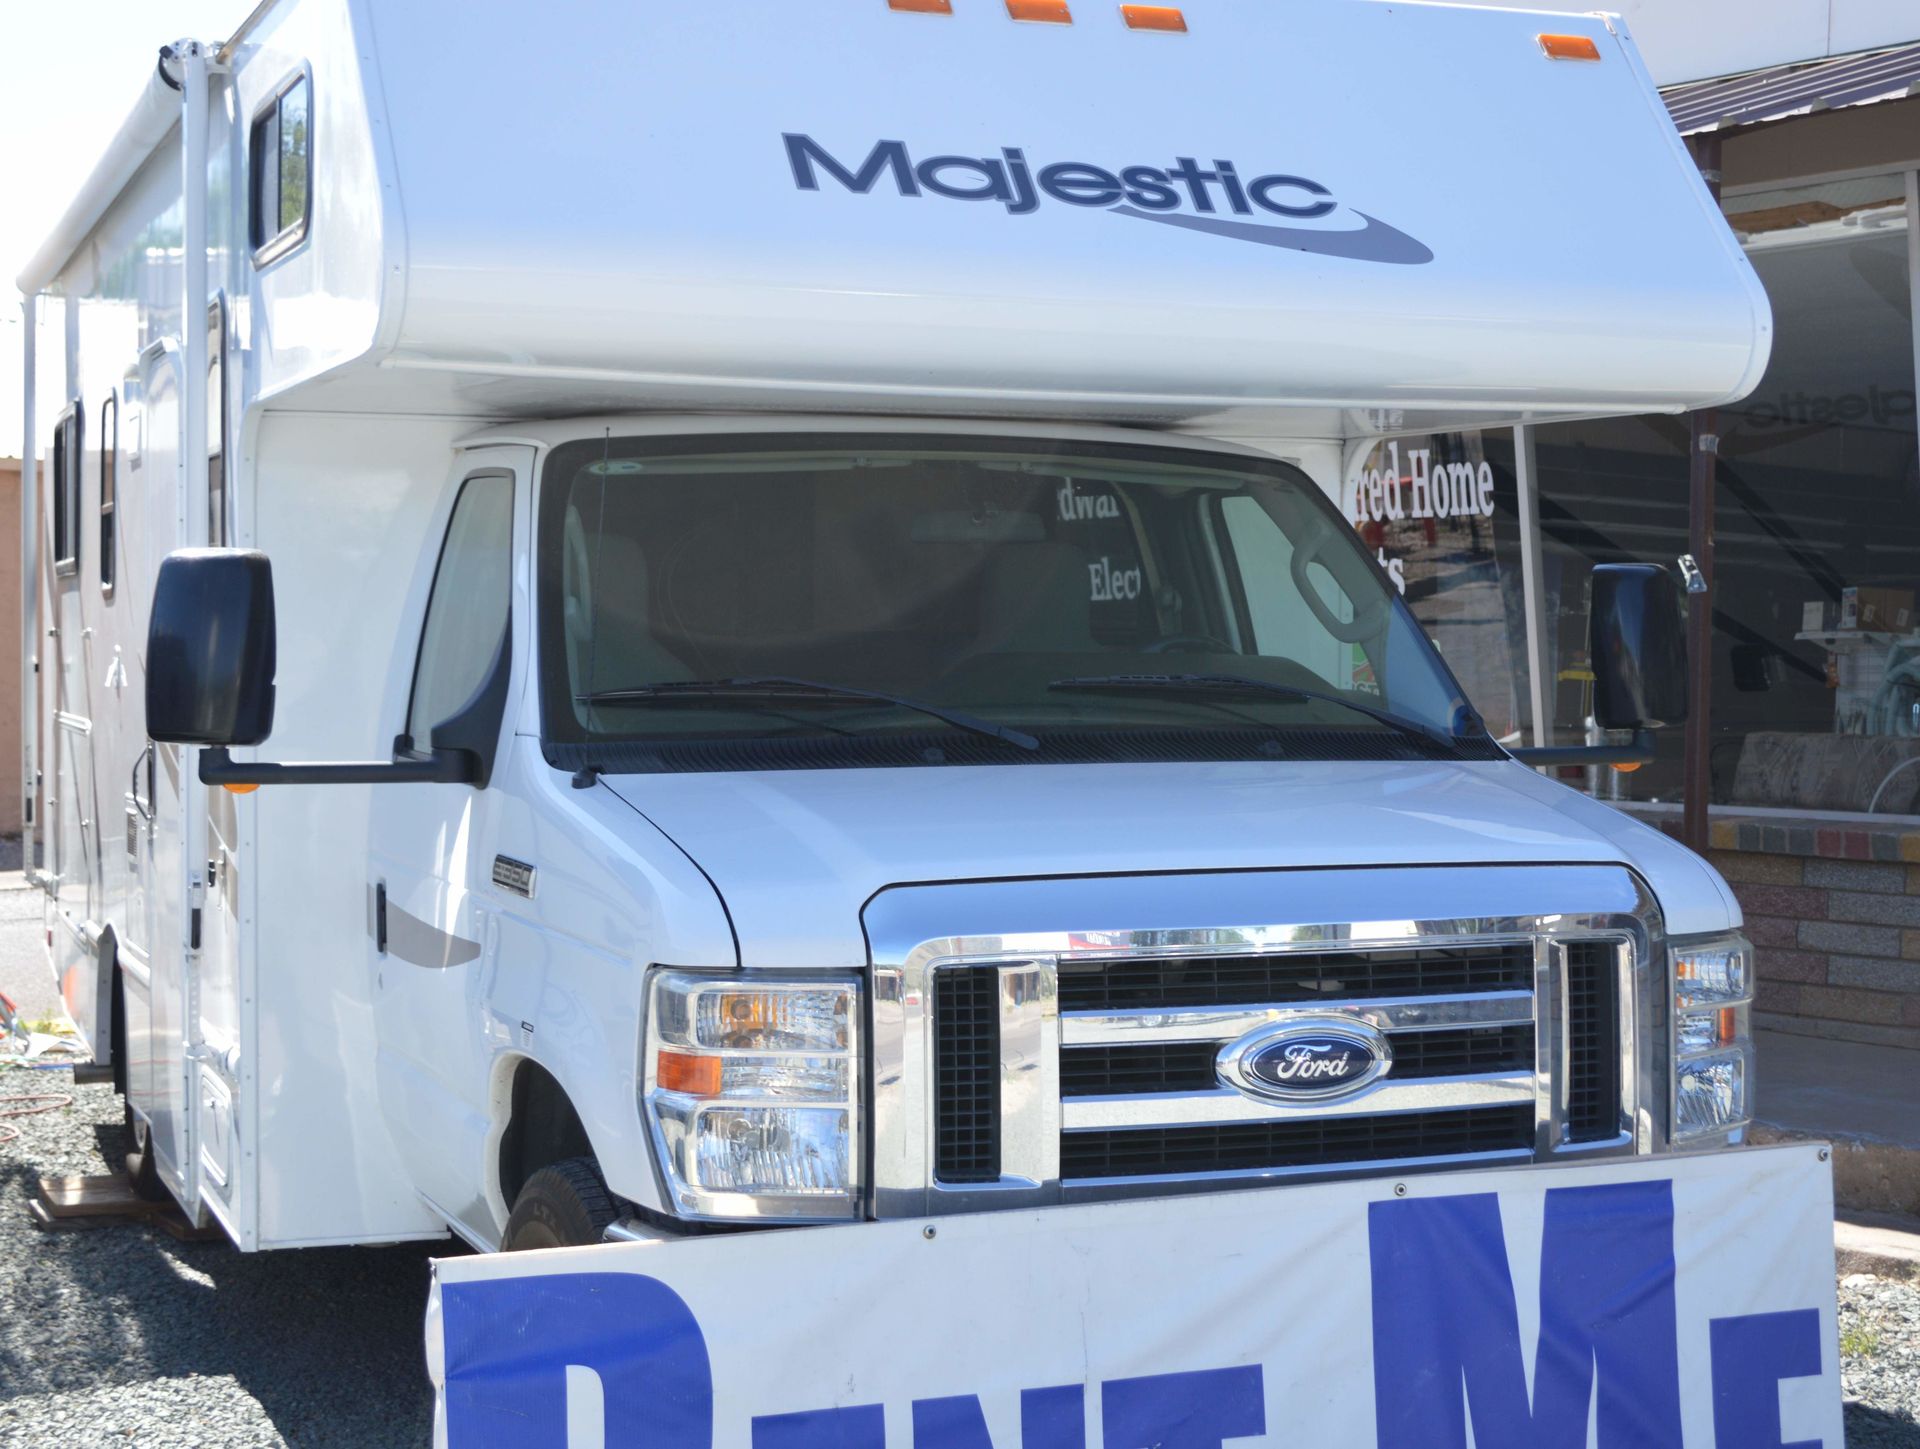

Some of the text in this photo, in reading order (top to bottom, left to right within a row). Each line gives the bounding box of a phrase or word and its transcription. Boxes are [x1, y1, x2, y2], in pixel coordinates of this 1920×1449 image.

[781, 132, 1338, 218] Majestic
[1408, 448, 1495, 519] Home
[1276, 1044, 1350, 1079] Ford
